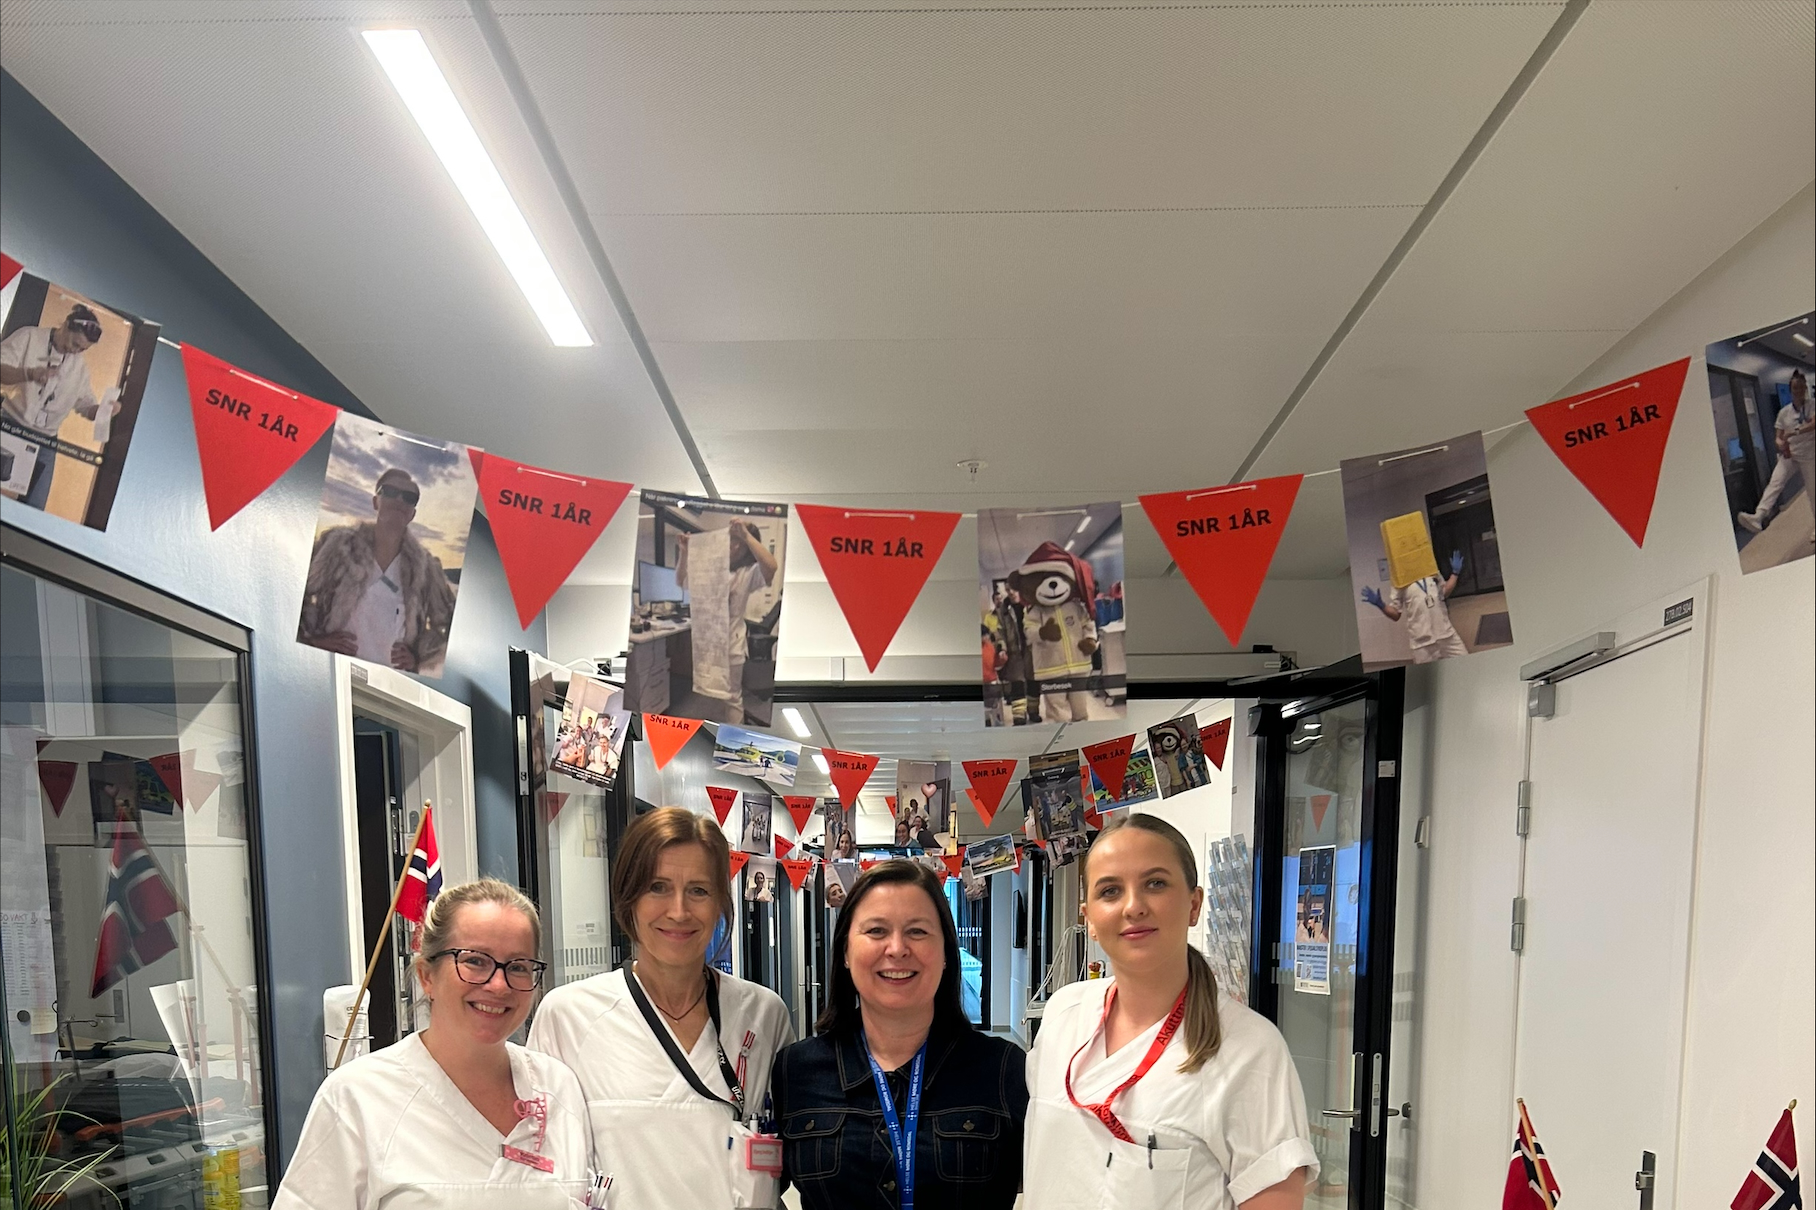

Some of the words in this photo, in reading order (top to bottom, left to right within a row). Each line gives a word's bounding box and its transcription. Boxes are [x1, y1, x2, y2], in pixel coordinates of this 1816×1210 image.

[205, 388, 252, 421] SNR
[257, 413, 299, 442] 1ÅR
[1564, 422, 1609, 448] SNR
[1615, 404, 1661, 432] 1ÅR
[498, 489, 544, 515] SNR
[551, 502, 592, 527] 1ÅR
[1176, 517, 1221, 537] SNR
[1228, 507, 1272, 531] 1ÅR
[830, 536, 874, 555] SNR
[883, 537, 924, 559] 1ÅR
[649, 714, 669, 726] SNR
[671, 718, 690, 731] 1ÅR
[831, 760, 848, 770] SNR
[851, 760, 868, 771] 1ÅR
[1092, 753, 1109, 763] SNR
[1110, 748, 1126, 759] 1ÅR
[972, 769, 989, 779] SNR
[991, 767, 1008, 777] 1ÅR
